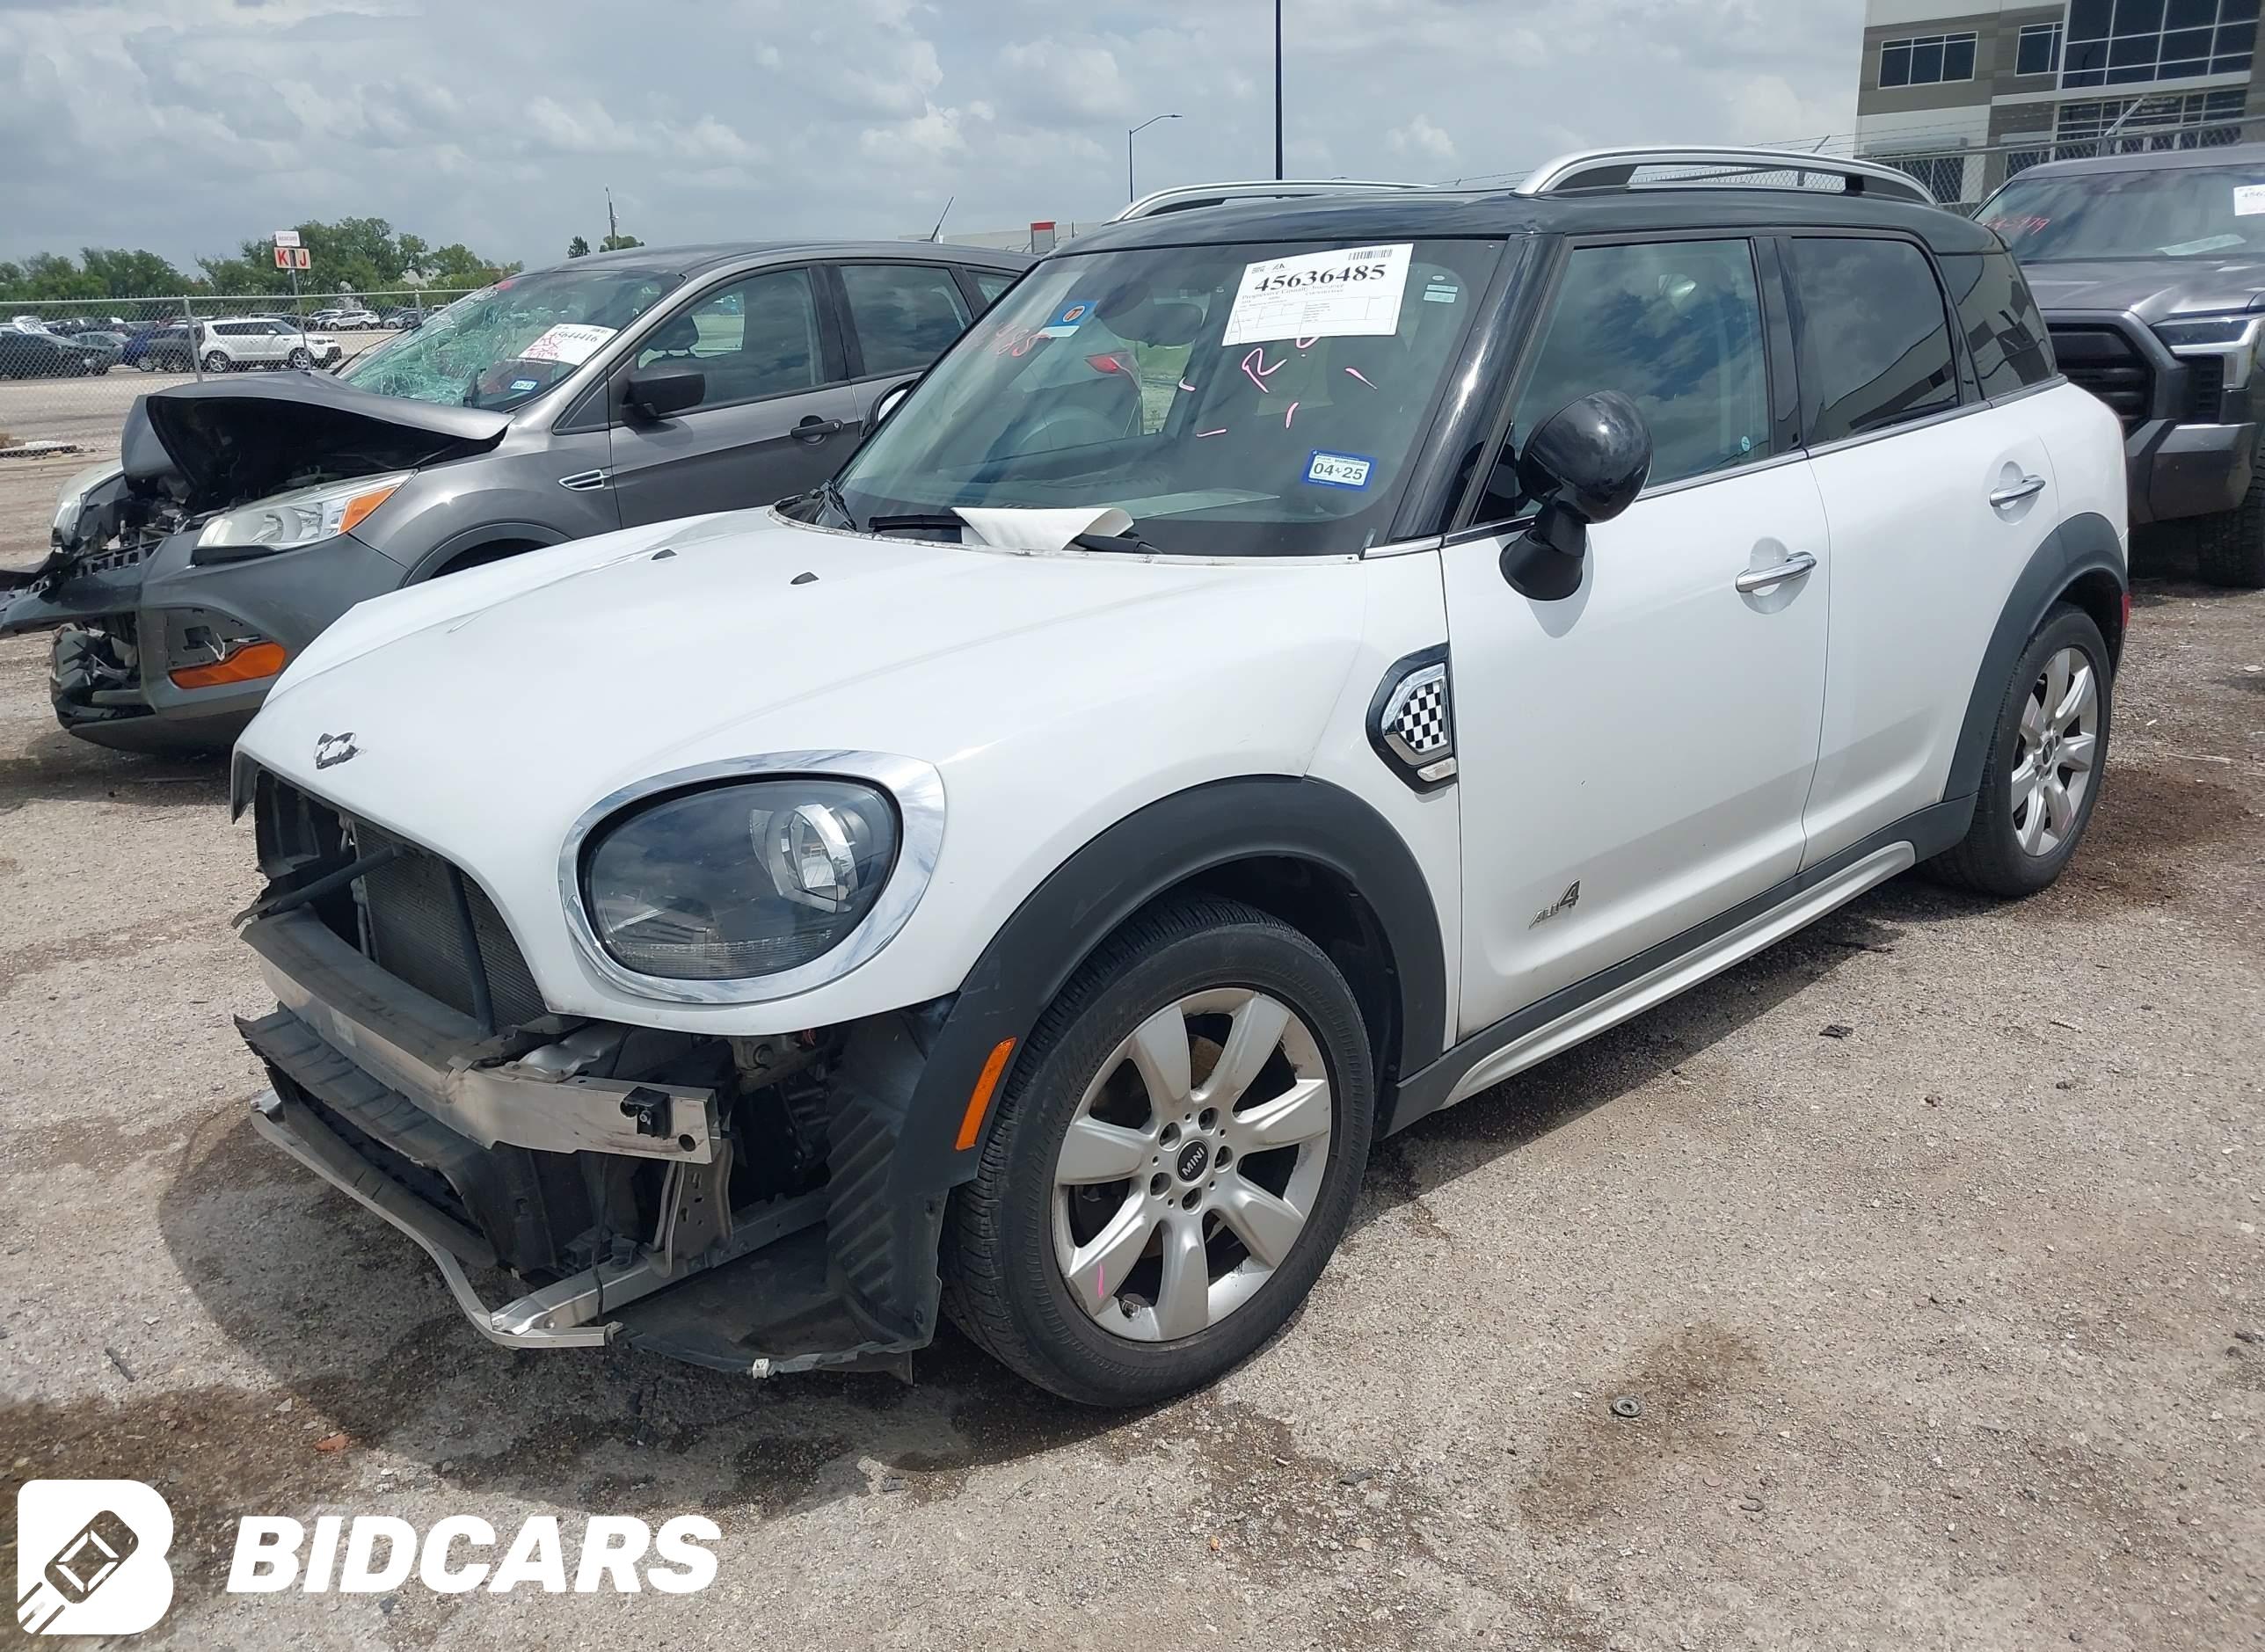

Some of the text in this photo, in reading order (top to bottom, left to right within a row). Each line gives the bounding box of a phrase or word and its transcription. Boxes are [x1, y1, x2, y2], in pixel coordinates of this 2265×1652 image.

[277, 250, 307, 266] K J
[1254, 264, 1387, 292] 45636485
[1314, 462, 1365, 480] 04 25
[1181, 1146, 1205, 1176] MINI
